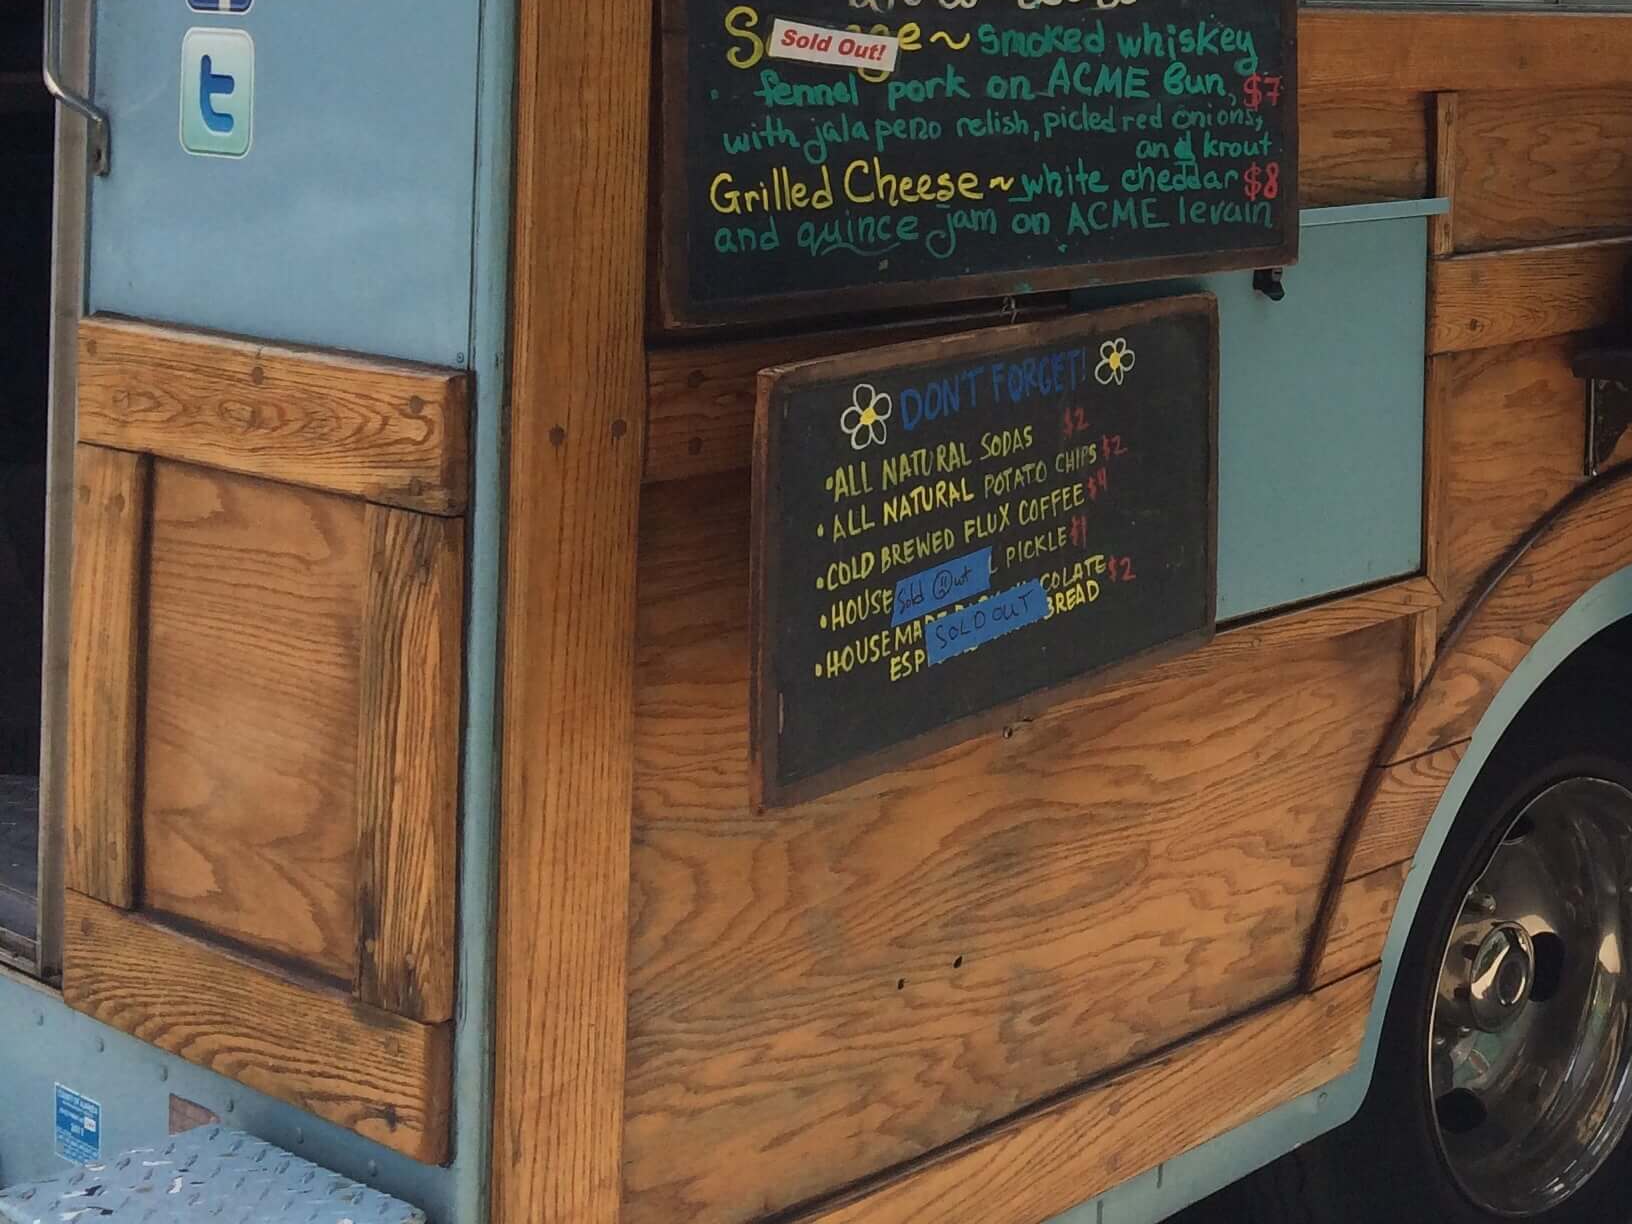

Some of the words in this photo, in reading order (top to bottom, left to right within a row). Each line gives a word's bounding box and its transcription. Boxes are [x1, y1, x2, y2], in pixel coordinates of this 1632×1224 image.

[781, 29, 832, 53] Sold
[838, 38, 887, 62] Out!
[1117, 20, 1259, 76] whiskey
[753, 69, 859, 108] fennel
[888, 64, 970, 111] pork
[986, 75, 1036, 101] on
[1047, 57, 1150, 98] ACME
[1243, 73, 1281, 111] $7
[722, 115, 800, 155] with
[1122, 104, 1163, 131] red
[1135, 130, 1196, 162] and
[1203, 130, 1272, 158] krout
[709, 165, 833, 215] Grilled
[843, 156, 984, 208] Cheese
[1018, 157, 1109, 201] white
[1122, 162, 1240, 192] cheddar
[1243, 161, 1280, 201] $8
[714, 216, 780, 254] and
[797, 210, 919, 257] quince
[926, 207, 997, 259] jam
[1011, 210, 1050, 235] on
[1067, 197, 1170, 236] ACME
[1179, 196, 1274, 230] levain
[991, 346, 1087, 404] FORGET!
[833, 461, 874, 504] ALL
[881, 441, 972, 491] NATURAL
[979, 424, 1034, 461] SODAS
[833, 504, 876, 544] ALL
[883, 479, 975, 526] NATURAL
[984, 460, 1048, 499] POTATO
[1055, 443, 1097, 474] CHIPS
[827, 552, 875, 591] COLD
[881, 528, 955, 574] BREWED
[964, 503, 1010, 544] FLUX
[1018, 483, 1085, 526] COFFEE
[832, 589, 894, 632] HOUSE
[1006, 526, 1067, 569] PICKLE
[827, 630, 891, 679] HOUSE
[1108, 555, 1137, 582] $2
